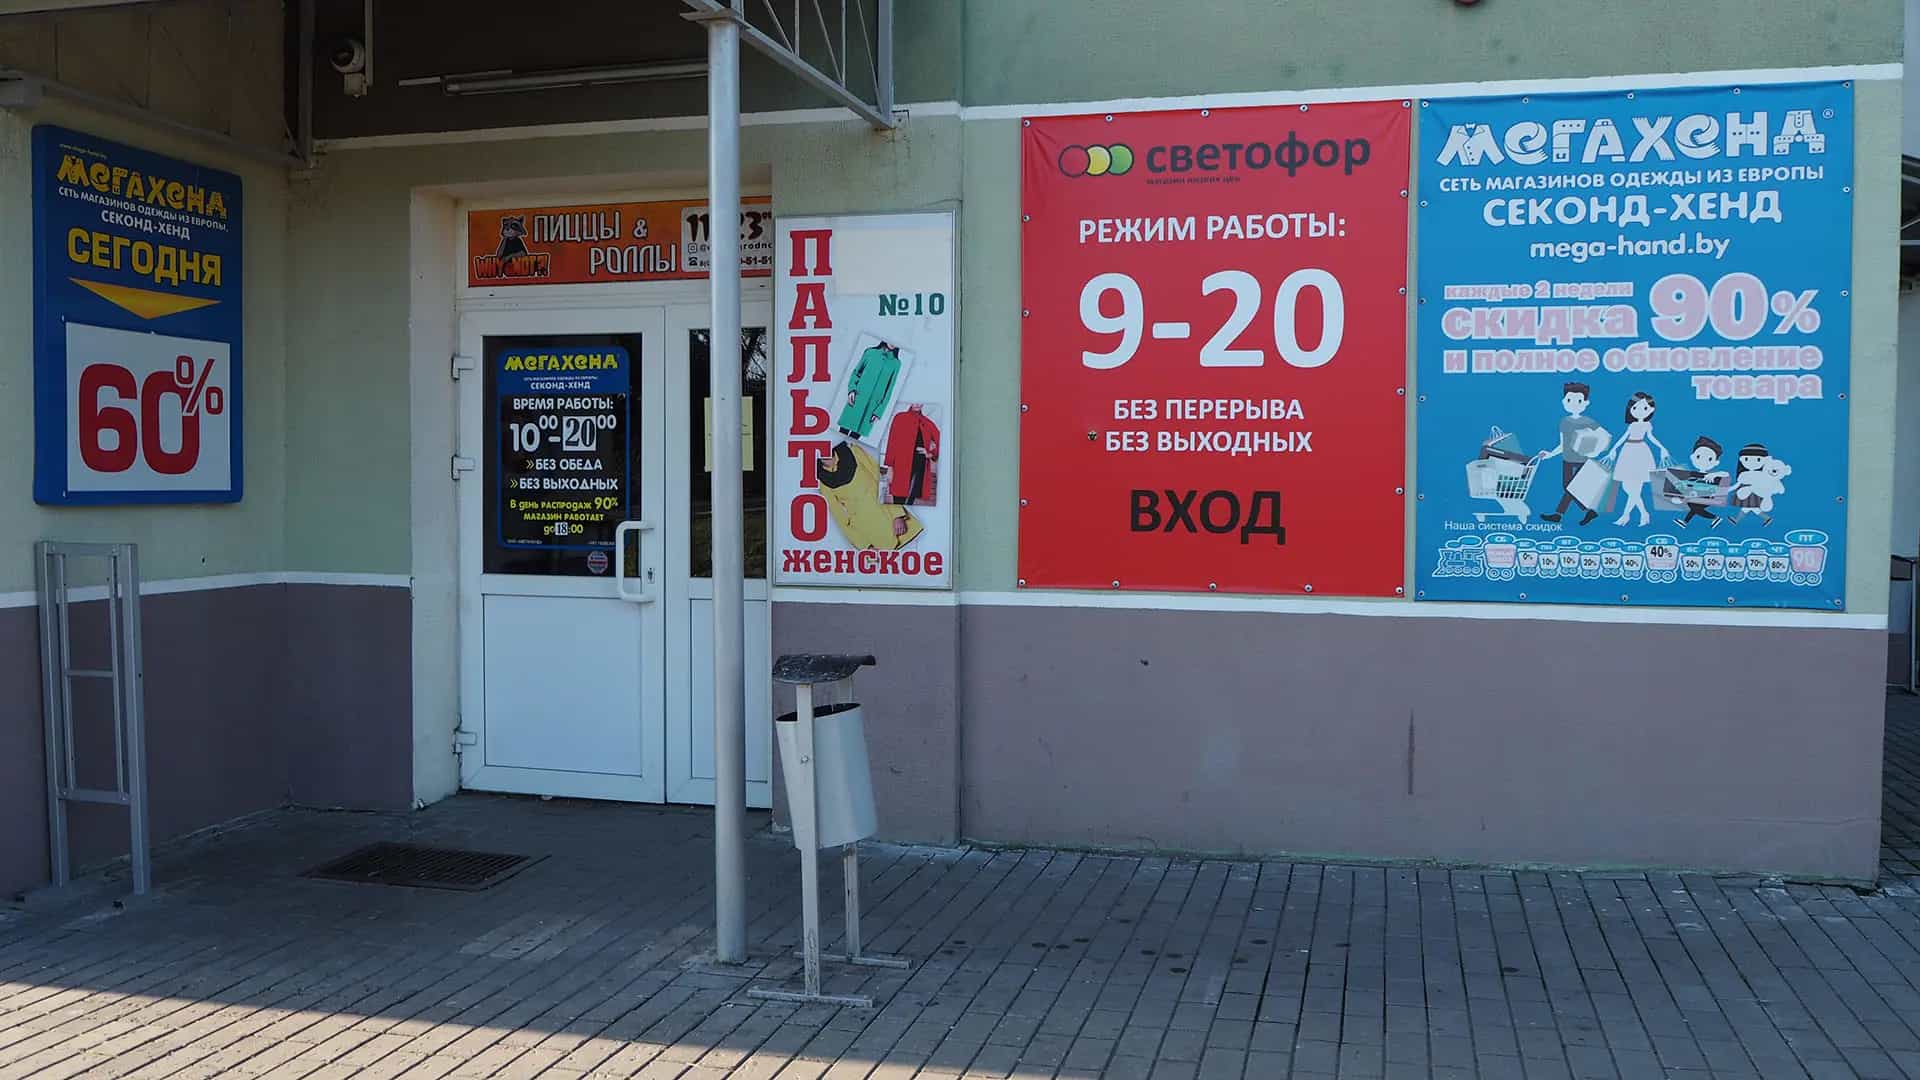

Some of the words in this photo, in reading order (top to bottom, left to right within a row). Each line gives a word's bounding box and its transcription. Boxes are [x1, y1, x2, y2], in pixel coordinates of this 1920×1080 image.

[1146, 131, 1372, 177] светофор
[1439, 176, 1482, 192] СЕТЬ
[1486, 173, 1606, 191] МАГАЗИНОВ
[1610, 170, 1702, 189] ОДЕЖДЫ
[1707, 168, 1735, 184] ИЗ
[1739, 165, 1824, 182] ЕВРОПЫ
[58, 186, 80, 200] СЕТЬ
[80, 191, 137, 213] МАГАЗИНОВ
[137, 204, 177, 221] ОДЕЖДЫ
[178, 213, 191, 224] ИЗ
[1483, 190, 1783, 229] СЕКОНД-ХЕНД
[100, 209, 191, 241] СЕКОНД-ХЕНД
[533, 211, 620, 243] ПИЦЦЫ
[632, 218, 648, 238] &
[1079, 216, 1196, 243] РЕЖИМ
[1206, 212, 1346, 240] РАБОТЫ:
[67, 227, 221, 287] СЕГОДНЯ
[590, 244, 676, 274] РОЛЛЫ
[1529, 232, 1730, 264] mega-hand.by
[1444, 284, 1531, 302] каждые
[1534, 281, 1551, 299] 2
[1553, 281, 1634, 299] недели
[1079, 268, 1345, 369] 9-20
[1441, 303, 1639, 345] скидка
[1648, 272, 1821, 342] 90%
[1443, 348, 1468, 373] и
[1472, 346, 1600, 373] полное
[1603, 342, 1823, 372] обновление
[530, 382, 591, 390] СЕКОНД-ХЕНД
[787, 229, 833, 542] ПАЛЬТО
[1691, 373, 1823, 404] товара
[78, 355, 224, 475] 60%
[513, 398, 554, 410] ВРЕМЯ
[557, 397, 614, 410] РАБОТЫ:
[1114, 400, 1158, 420] БЕЗ
[1166, 399, 1304, 420] ПЕРЕРЫВА
[1106, 432, 1149, 451] БЕЗ
[1157, 431, 1312, 456] ВЫХОДНЫХ
[559, 459, 603, 471] ОБЕДА
[543, 477, 618, 490] ВЫХОДНЫХ
[594, 497, 618, 510] 90%
[1131, 489, 1286, 545] ВХОД
[1444, 520, 1475, 531] Наша
[1478, 521, 1522, 531] система
[1525, 521, 1563, 532] скидок
[1650, 546, 1673, 558] 40%
